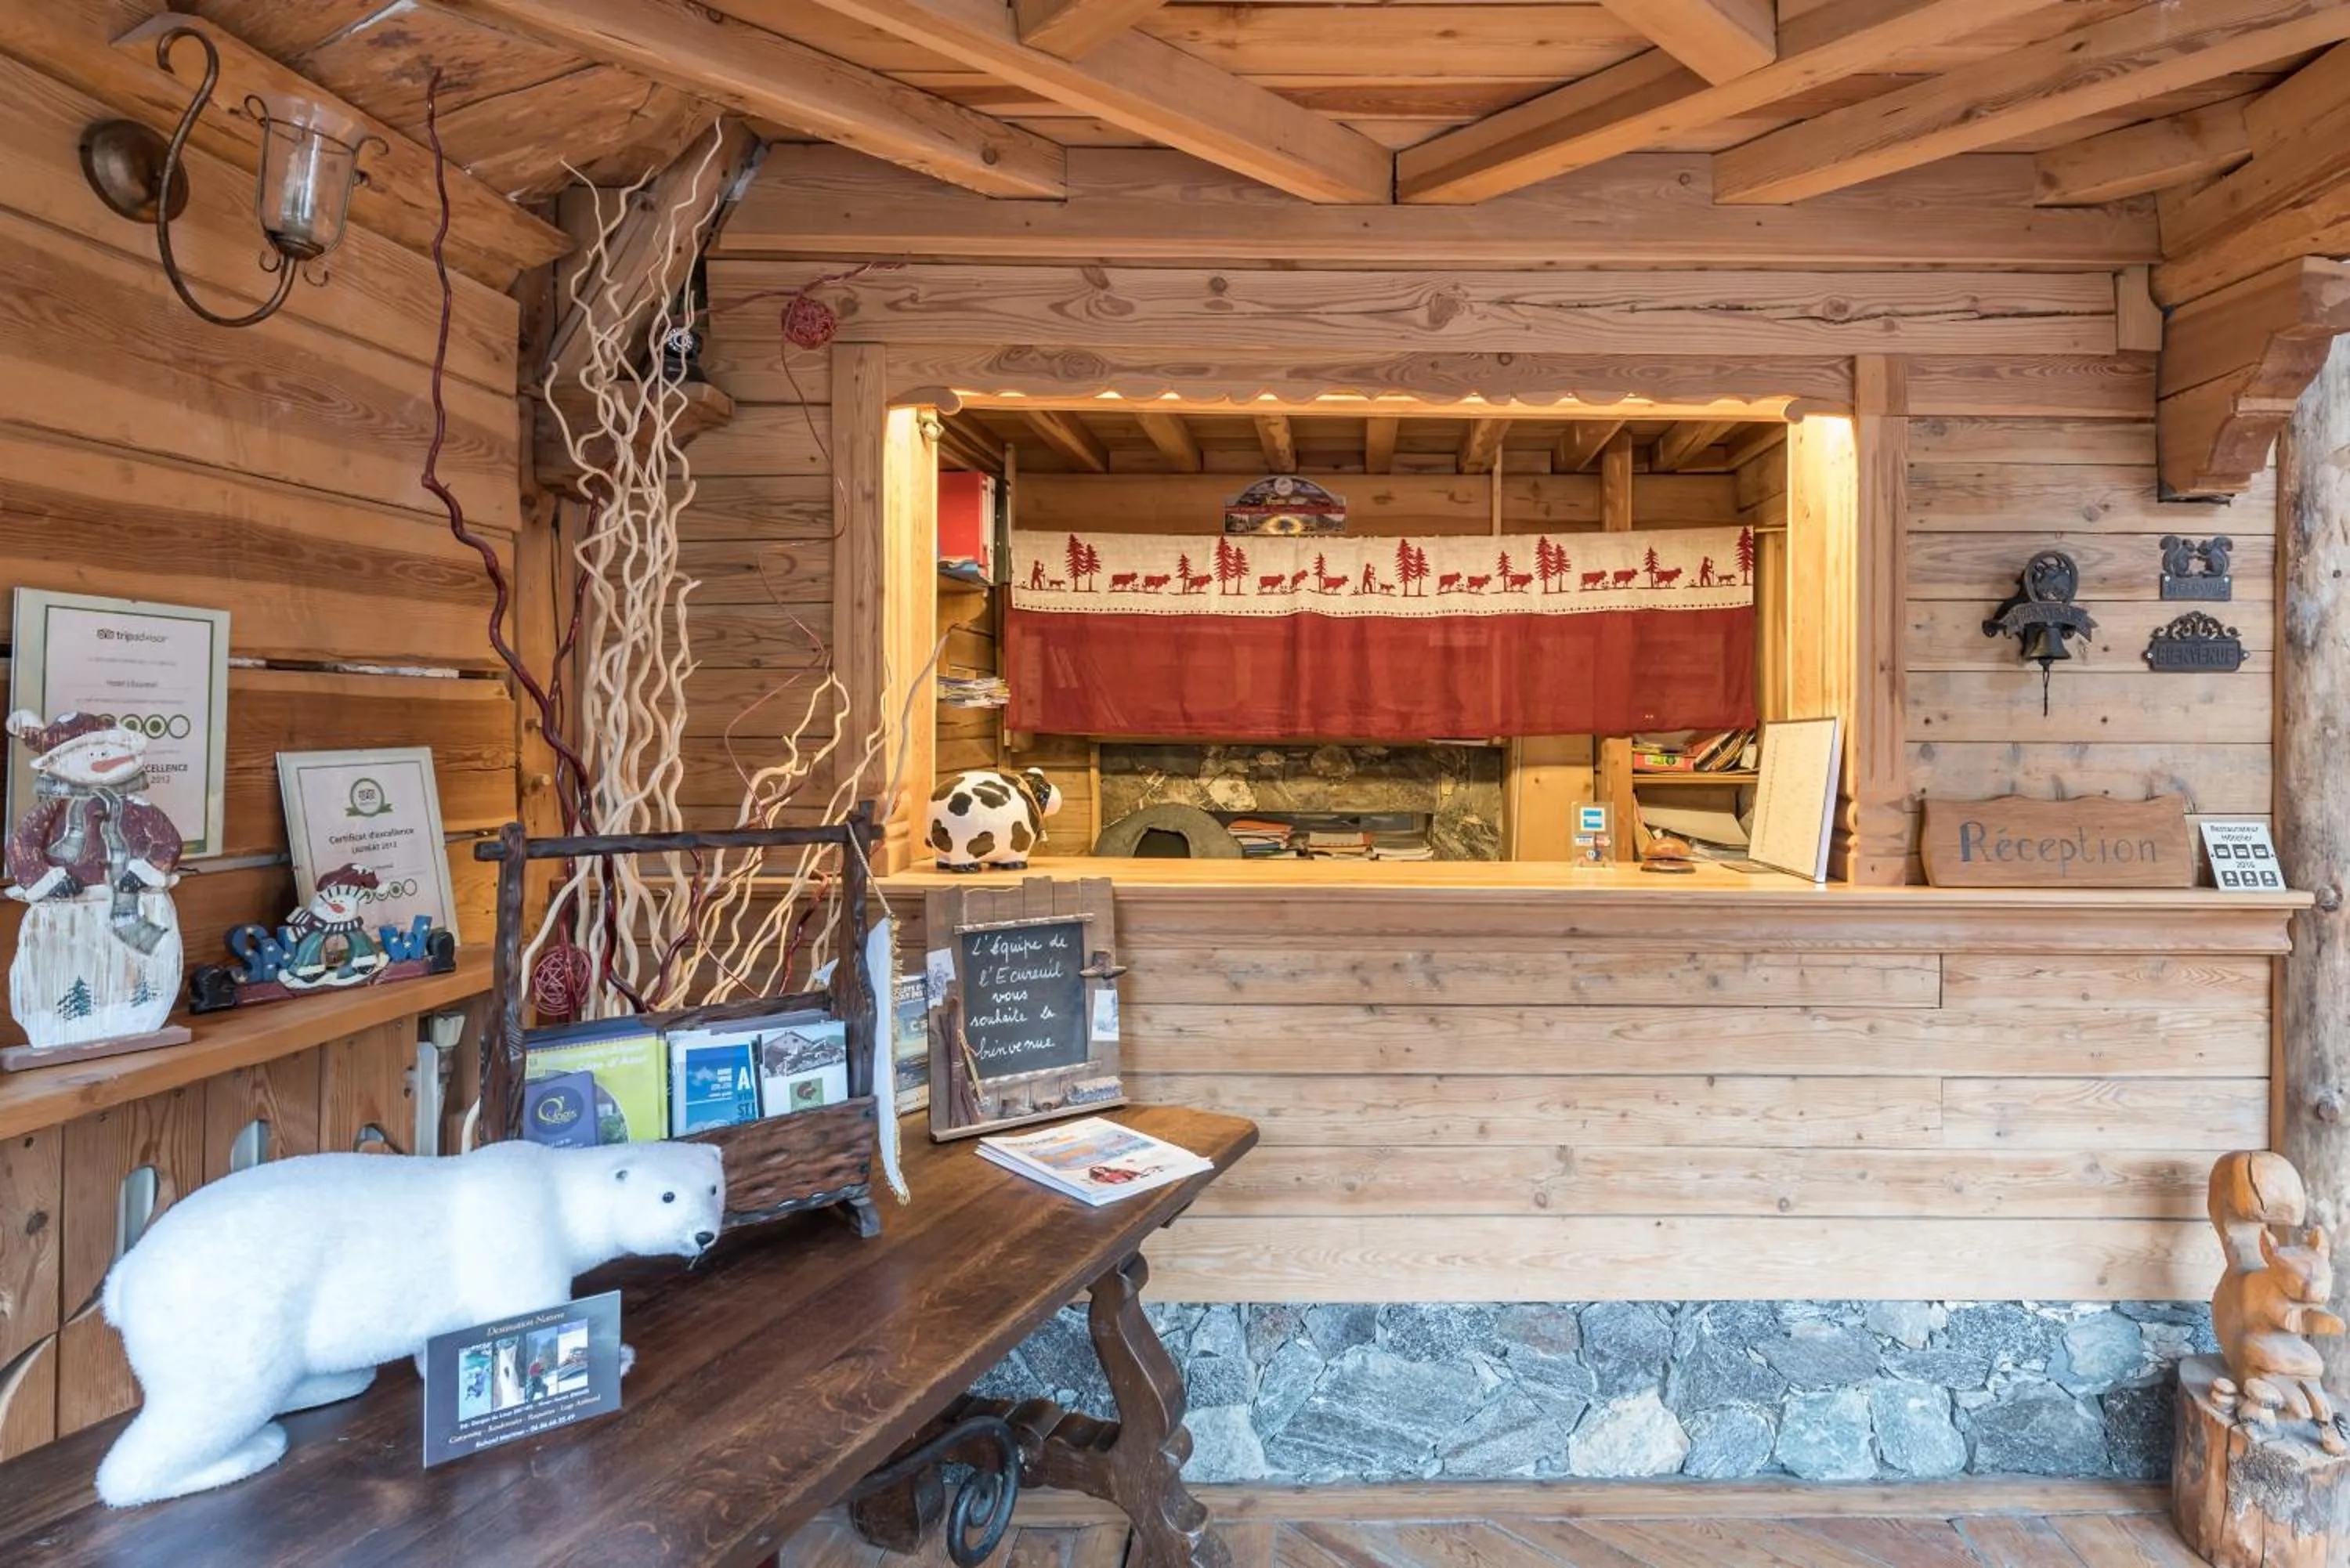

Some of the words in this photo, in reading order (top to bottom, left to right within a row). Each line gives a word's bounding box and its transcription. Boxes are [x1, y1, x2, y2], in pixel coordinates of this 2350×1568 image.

[2157, 645, 2236, 666] BIENVENUE
[1959, 821, 2157, 878] Réception
[1050, 933, 1068, 948] de
[992, 990, 1028, 1003] vous
[970, 1006, 1028, 1028] souhaite
[1039, 1005, 1057, 1020] la
